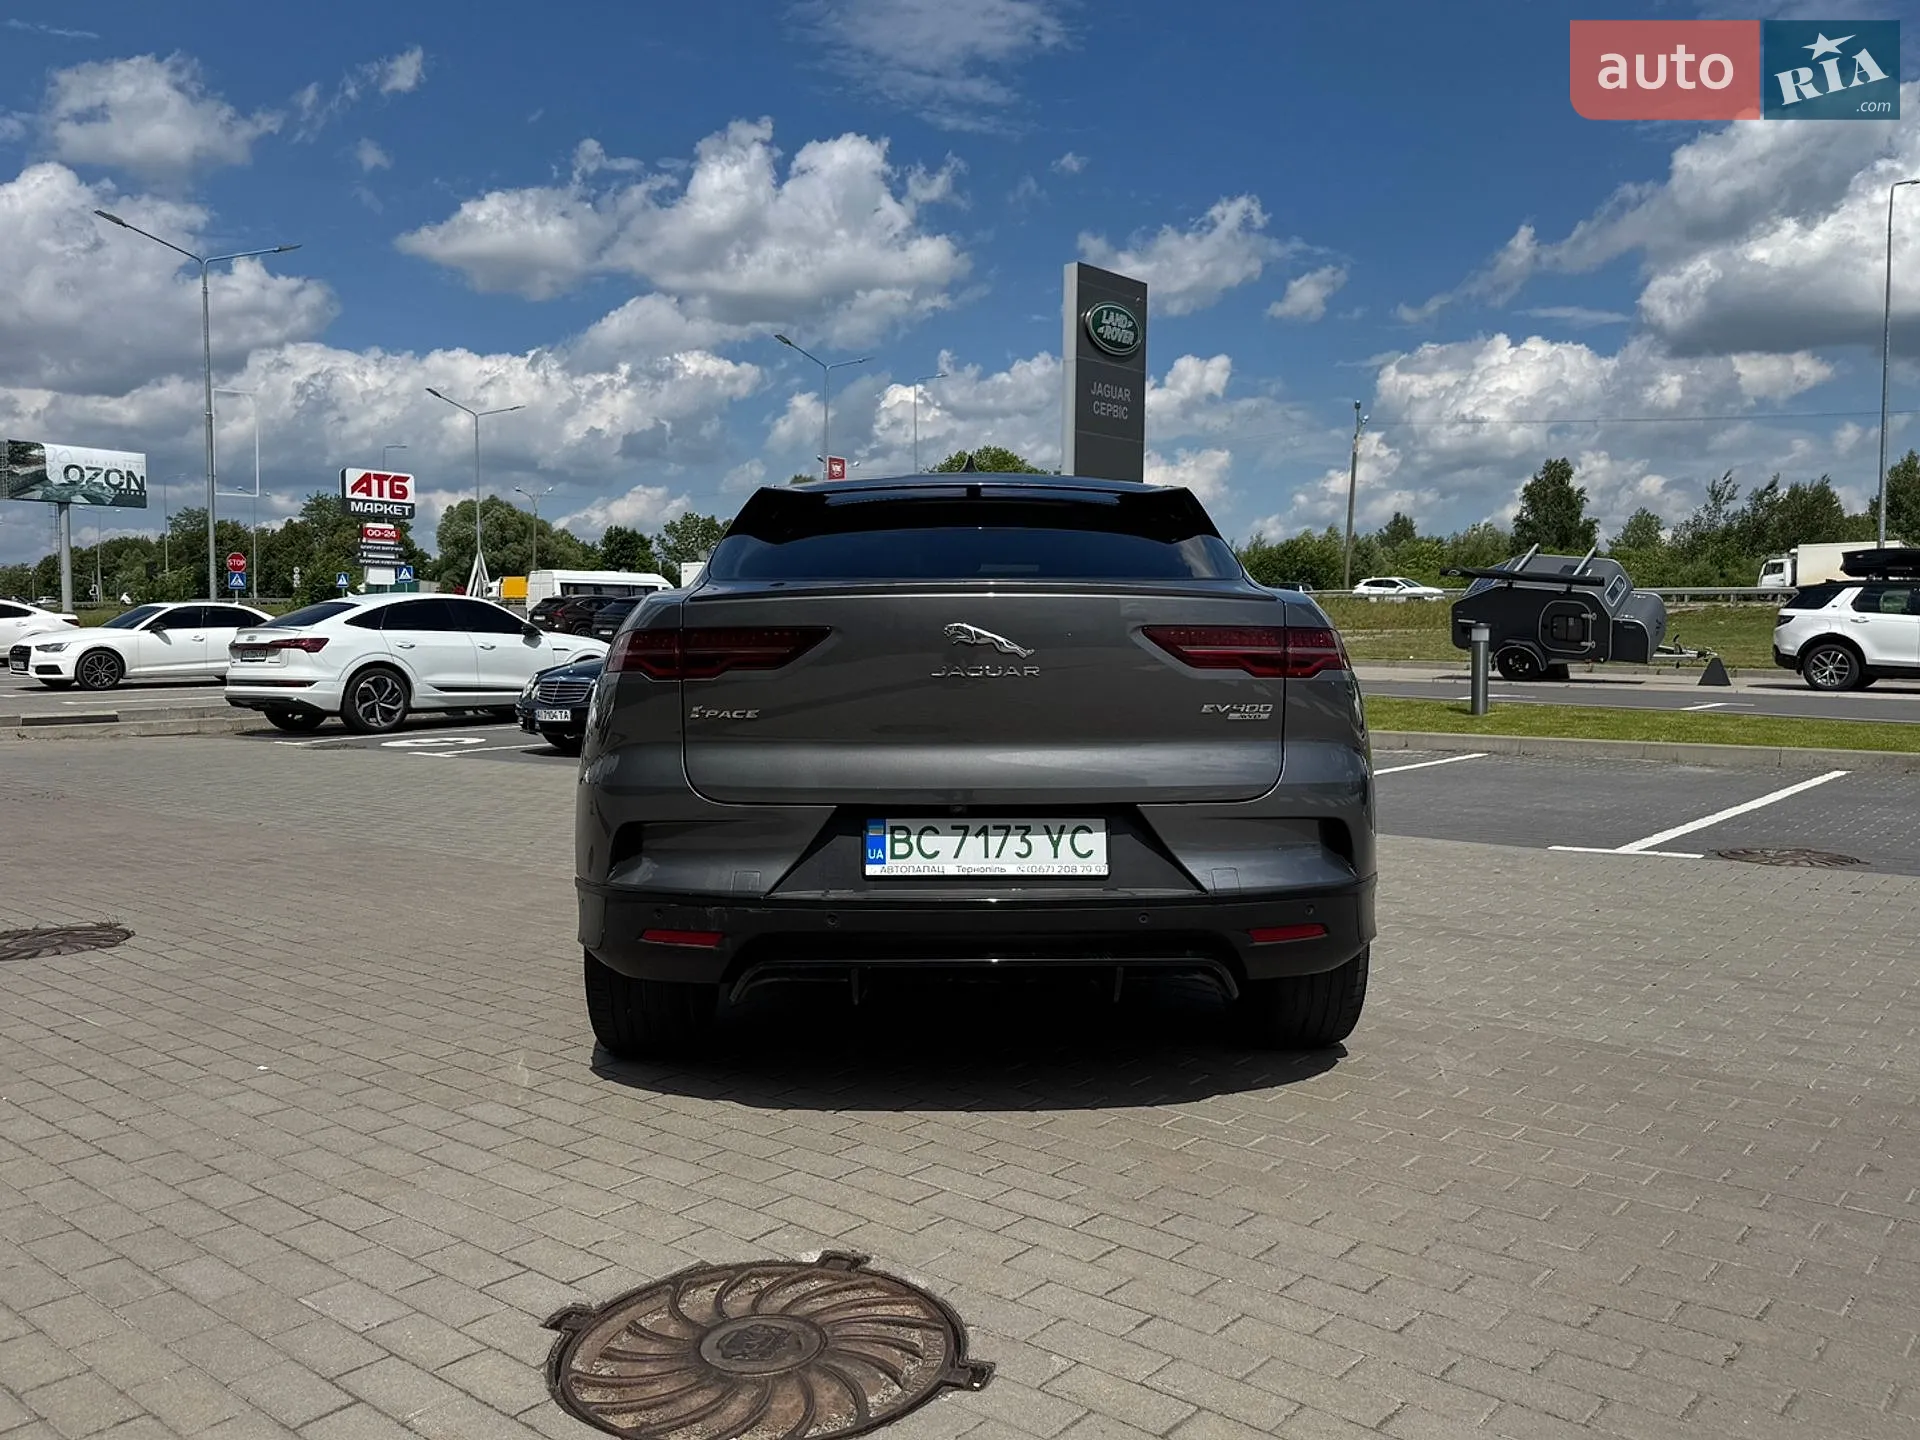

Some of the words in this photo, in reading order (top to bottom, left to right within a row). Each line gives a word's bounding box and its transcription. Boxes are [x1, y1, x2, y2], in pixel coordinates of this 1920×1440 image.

[1101, 309, 1128, 329] LAND
[1102, 325, 1135, 345] ROVER
[1090, 382, 1131, 402] JAGUAR
[1093, 401, 1129, 420] СЕРВІС
[63, 464, 145, 491] OZON
[350, 471, 411, 500] АТБ
[350, 501, 412, 516] МАРКЕТ
[229, 559, 246, 567] STOP
[930, 665, 1040, 677] JAGUAR
[1201, 704, 1274, 713] EV400
[889, 825, 940, 860] BC
[950, 825, 1033, 859] 7173
[1042, 824, 1095, 859] YC
[867, 849, 885, 860] UA
[1057, 865, 1078, 873] 208
